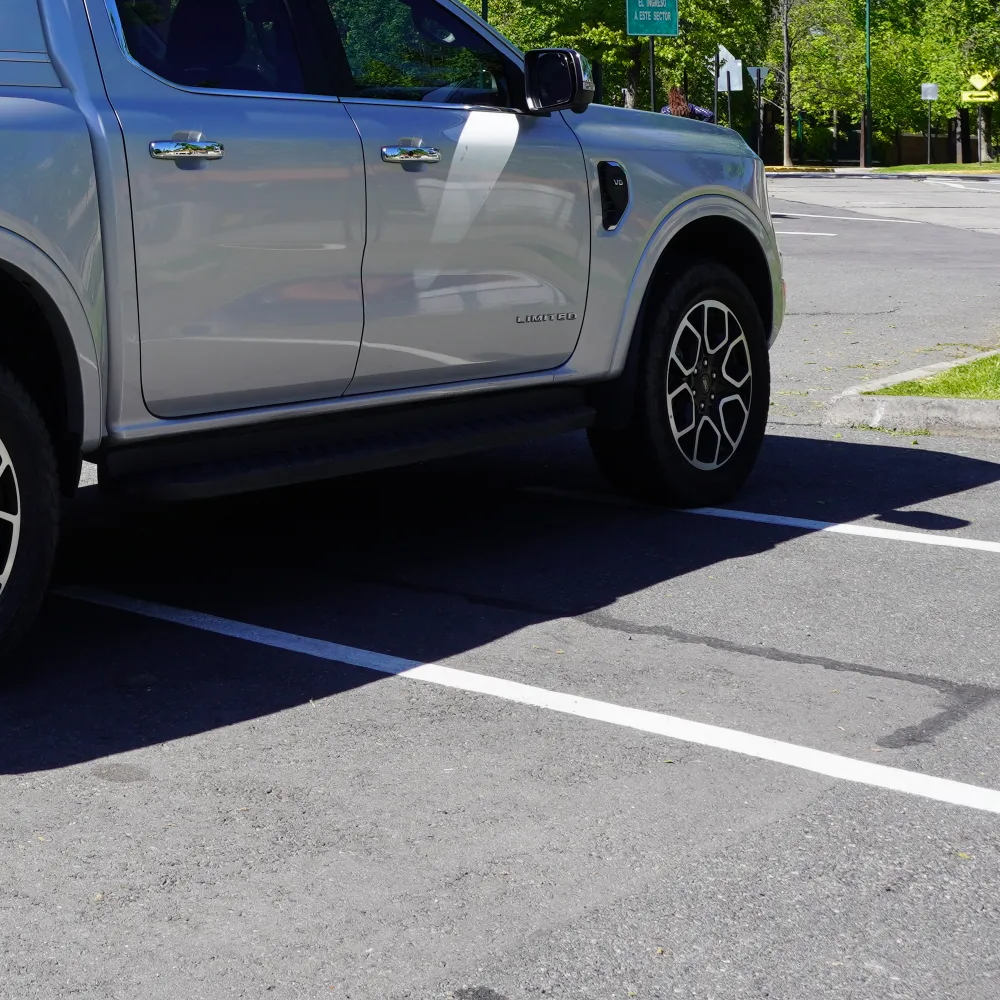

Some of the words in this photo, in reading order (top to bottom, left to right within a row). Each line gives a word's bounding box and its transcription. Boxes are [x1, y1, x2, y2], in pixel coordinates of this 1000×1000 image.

[634, 11, 638, 20] A
[639, 11, 652, 21] ESTE
[653, 11, 671, 21] SECTOR
[515, 312, 577, 324] LIMITED
